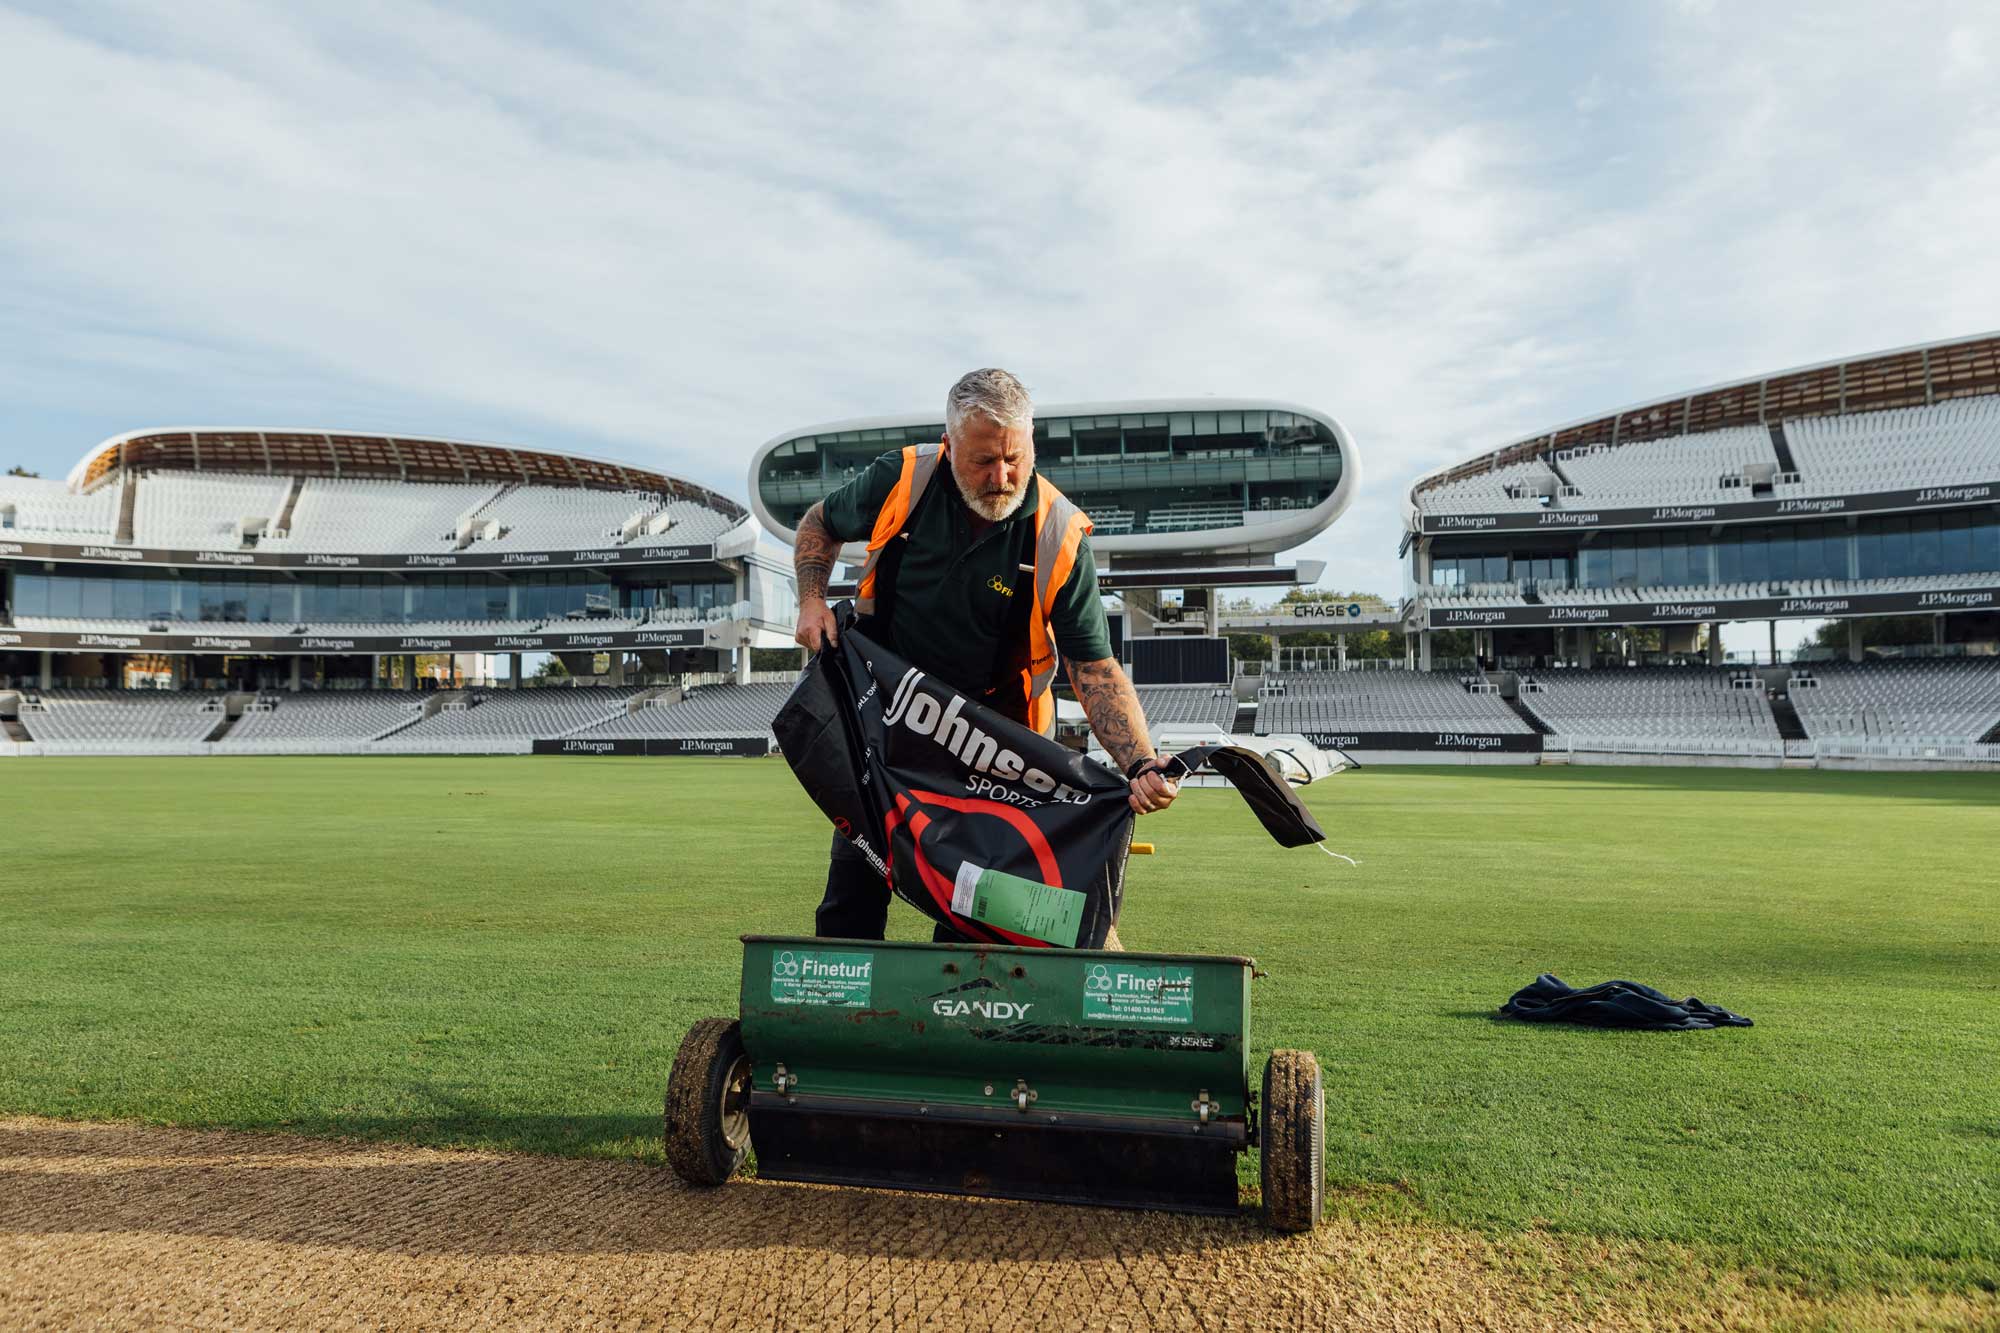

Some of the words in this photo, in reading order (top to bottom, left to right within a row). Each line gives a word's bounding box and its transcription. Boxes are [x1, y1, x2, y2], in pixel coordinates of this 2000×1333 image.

[1917, 486, 1990, 501] J.P.Morgan
[1778, 499, 1844, 512] J.P.Morgan
[1539, 513, 1599, 525] J.P.Morgan
[1653, 507, 1715, 520] J.P.Morgan
[1438, 516, 1497, 528] J.P.Morgan
[502, 553, 549, 564] J.P.Morgan
[573, 551, 620, 562] J.P.Morgan
[642, 547, 689, 559] J.P.Morgan
[406, 555, 456, 567] J.P.Morgan
[1918, 591, 1993, 605] J.P.Morgan
[1294, 605, 1345, 617] CHASE
[1652, 604, 1716, 616] J.P.Morgan
[1780, 600, 1849, 612] J.P.Morgan
[1446, 610, 1505, 623] J.P.Morgan
[1548, 608, 1609, 620] J.P.Morgan
[400, 637, 451, 649] J.P.Morgan
[494, 636, 543, 647] J.P.Morgan
[566, 634, 613, 645] J.P.Morgan
[635, 632, 683, 643] J.P.Morgan
[563, 741, 614, 753] J.P.Morgan
[680, 740, 733, 752] J.P.Morgan
[1305, 734, 1359, 748] P.Morgan
[1435, 734, 1501, 749] J.P.Morgan
[965, 775, 1043, 808] SPORTS
[852, 833, 891, 875] Johnsons
[803, 959, 871, 978] Fineturf
[1117, 973, 1192, 993] Fineturf
[933, 999, 1032, 1020] GANDY
[1181, 1036, 1214, 1048] SERIES
